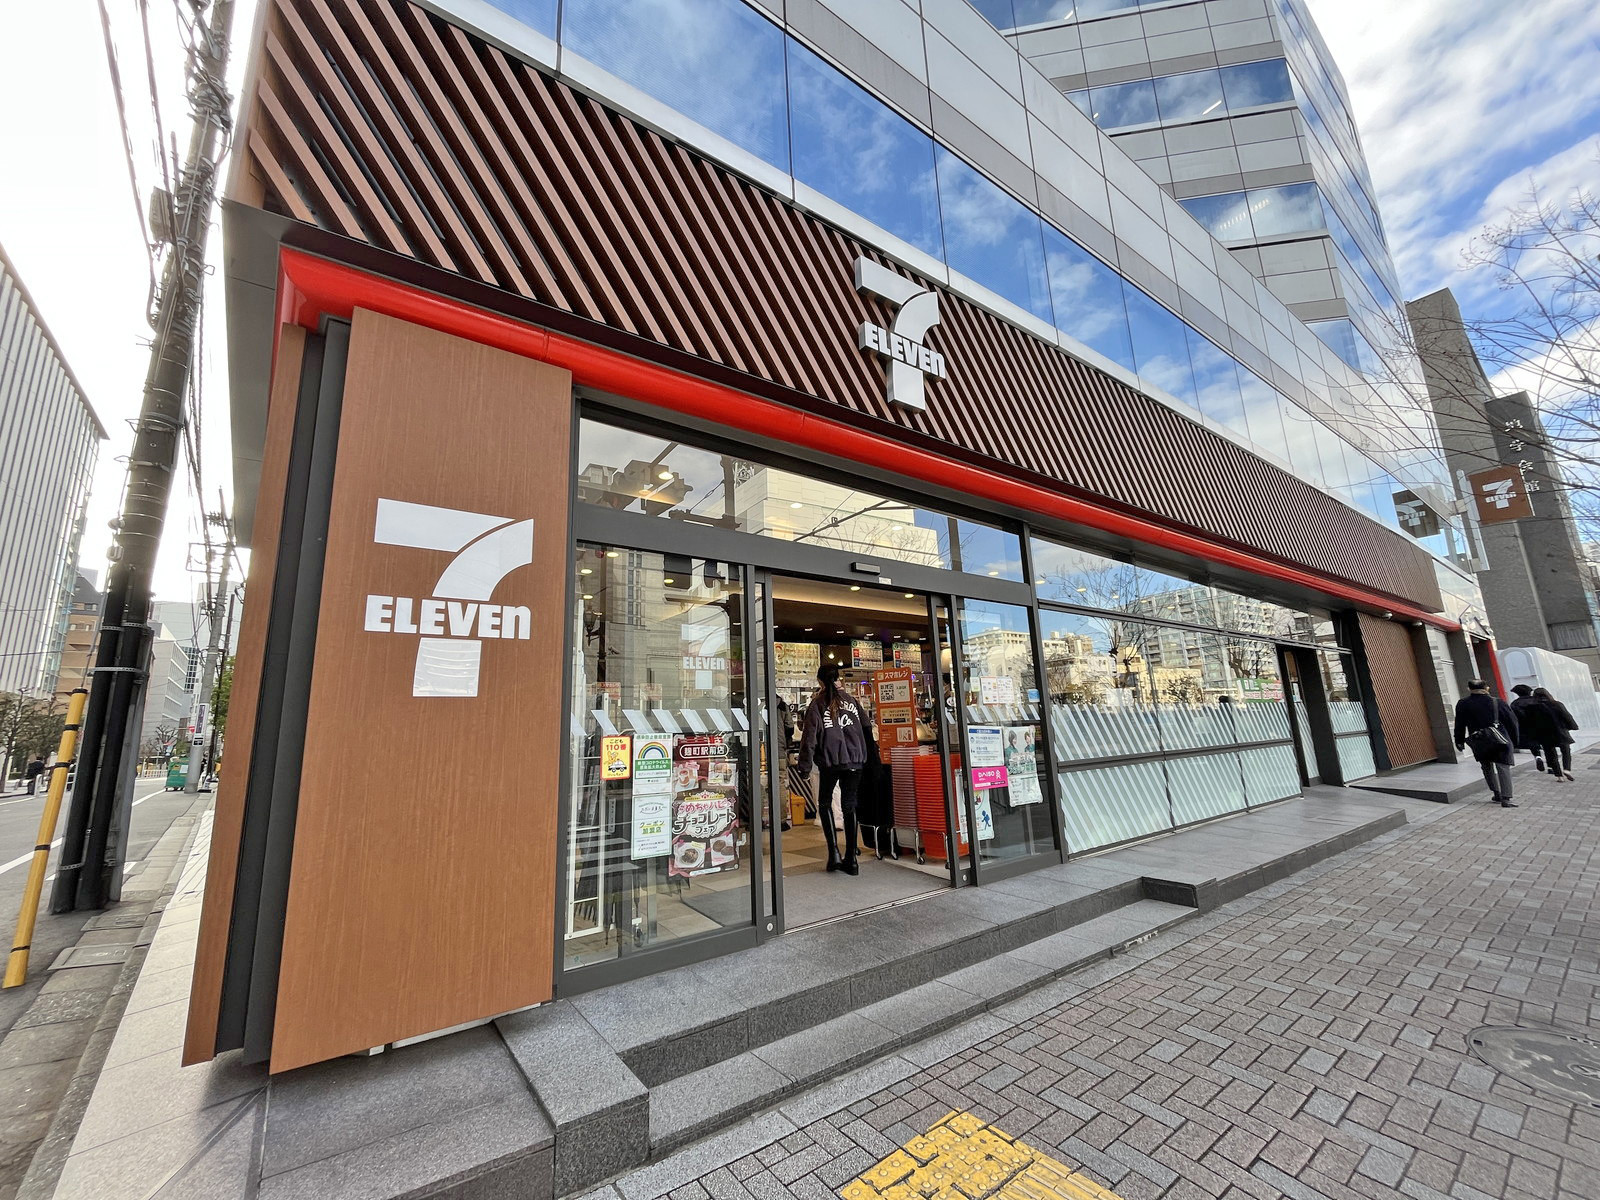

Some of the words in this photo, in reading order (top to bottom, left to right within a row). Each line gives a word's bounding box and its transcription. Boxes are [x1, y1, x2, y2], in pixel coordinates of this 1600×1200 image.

[854, 255, 940, 411] 7
[374, 498, 534, 697] 7
[681, 624, 726, 690] 7
[606, 743, 627, 751] 110番
[673, 808, 736, 833] チョコレート
[694, 825, 717, 834] フェア
